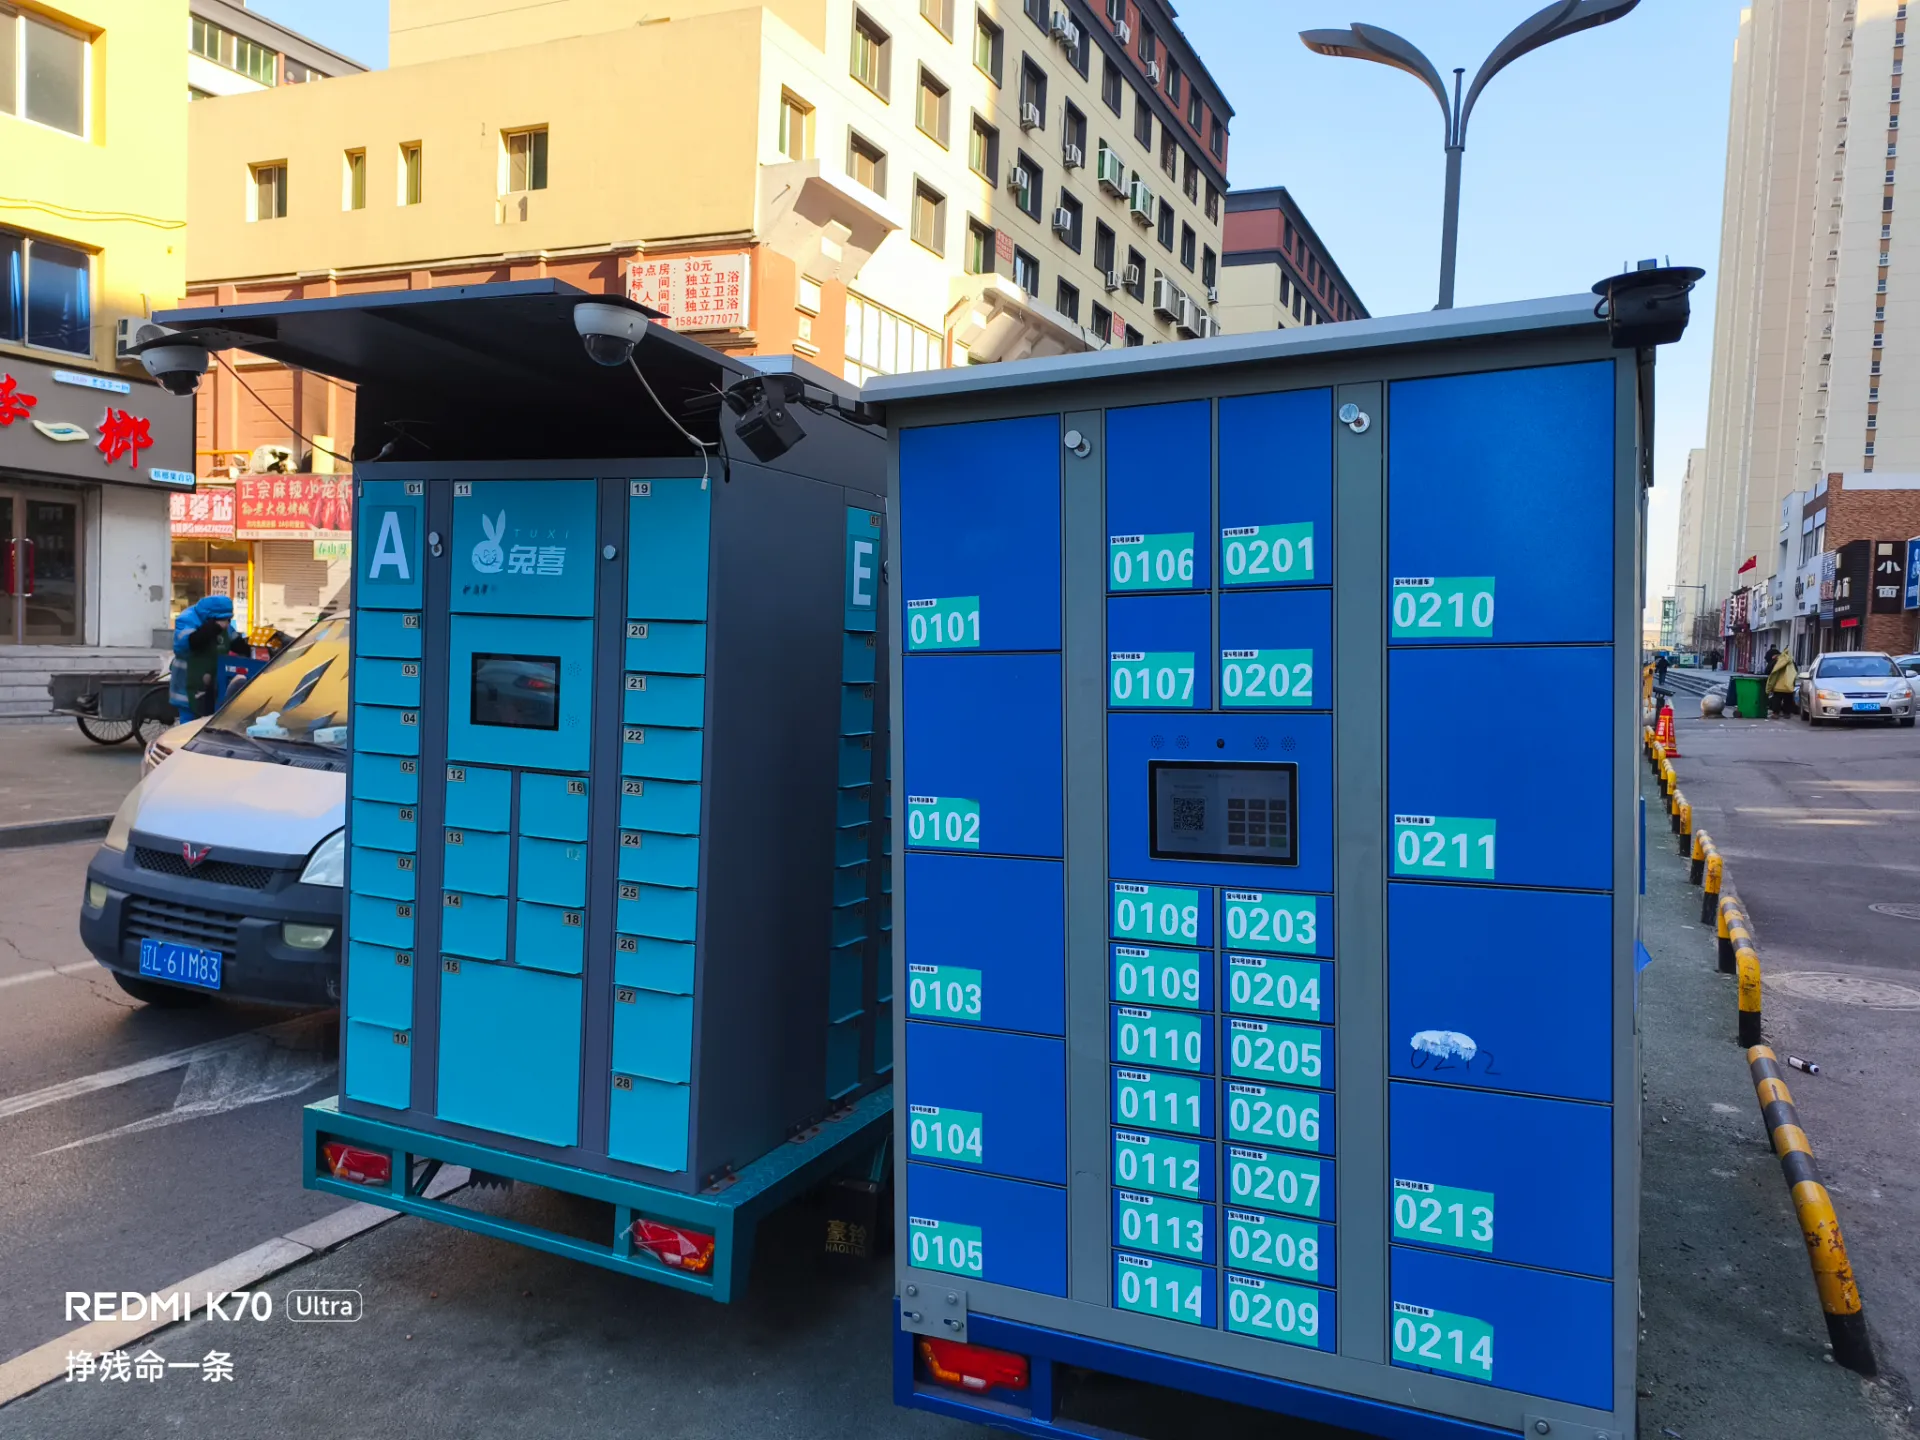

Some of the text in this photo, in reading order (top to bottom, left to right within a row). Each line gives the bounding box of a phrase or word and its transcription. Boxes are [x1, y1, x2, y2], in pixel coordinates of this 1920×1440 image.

[684, 259, 713, 272] 30元
[685, 270, 740, 286] 独立卫浴
[685, 284, 739, 299] 独立卫浴
[684, 297, 739, 313] 独立卫浴
[675, 312, 739, 327] 15842777077
[241, 480, 352, 499] 正宗麻辣小龙虾
[408, 483, 421, 493] 01
[458, 484, 469, 494] 11
[634, 483, 649, 494] 19
[369, 511, 410, 579] A
[507, 544, 567, 576] 兔喜
[1226, 538, 1312, 575] 0201
[853, 540, 873, 606] E
[1114, 549, 1193, 583] 0106
[1393, 592, 1494, 627] 0210
[405, 616, 417, 626] 02
[911, 611, 979, 644] 0101
[631, 625, 645, 636] 20
[404, 665, 416, 675] 03
[630, 678, 644, 688] 21
[1114, 668, 1194, 699] 0107
[1223, 664, 1312, 697] 0202
[403, 713, 416, 723] 04
[627, 730, 642, 741] 22
[402, 761, 414, 772] 05
[450, 769, 463, 780] 12
[570, 782, 583, 792] 16
[626, 782, 640, 793] 23
[400, 809, 413, 820] 06
[909, 810, 979, 842] 0102
[449, 832, 461, 843] 13
[624, 835, 639, 846] 24
[1398, 830, 1493, 869] 0211
[399, 858, 411, 868] 07
[446, 895, 460, 905] 14
[622, 887, 637, 898] 25
[398, 906, 410, 916] 08
[566, 913, 579, 924] 18
[1118, 899, 1197, 937] 0108
[1227, 907, 1316, 944] 0203
[620, 939, 635, 950] 26
[397, 953, 410, 964] 09
[445, 961, 458, 971] 15
[1119, 963, 1199, 1001] 0109
[619, 990, 634, 1002] 27
[910, 979, 981, 1013] 0103
[1231, 971, 1320, 1011] 0204
[395, 1033, 407, 1044] 10
[1120, 1024, 1201, 1063] 0110
[1232, 1035, 1321, 1077] 0205
[616, 1077, 630, 1089] 28
[1120, 1087, 1199, 1127] 0111
[1231, 1098, 1319, 1141] 0206
[911, 1119, 982, 1156] 0104
[1119, 1149, 1199, 1191] 0112
[1232, 1162, 1319, 1206] 0207
[1395, 1194, 1493, 1242] 0213
[1122, 1209, 1203, 1252] 0113
[912, 1232, 982, 1271] 0105
[1230, 1226, 1317, 1271] 0208
[1121, 1271, 1201, 1317] 0114
[1229, 1290, 1318, 1337] 0209
[1394, 1318, 1492, 1370] 0214
